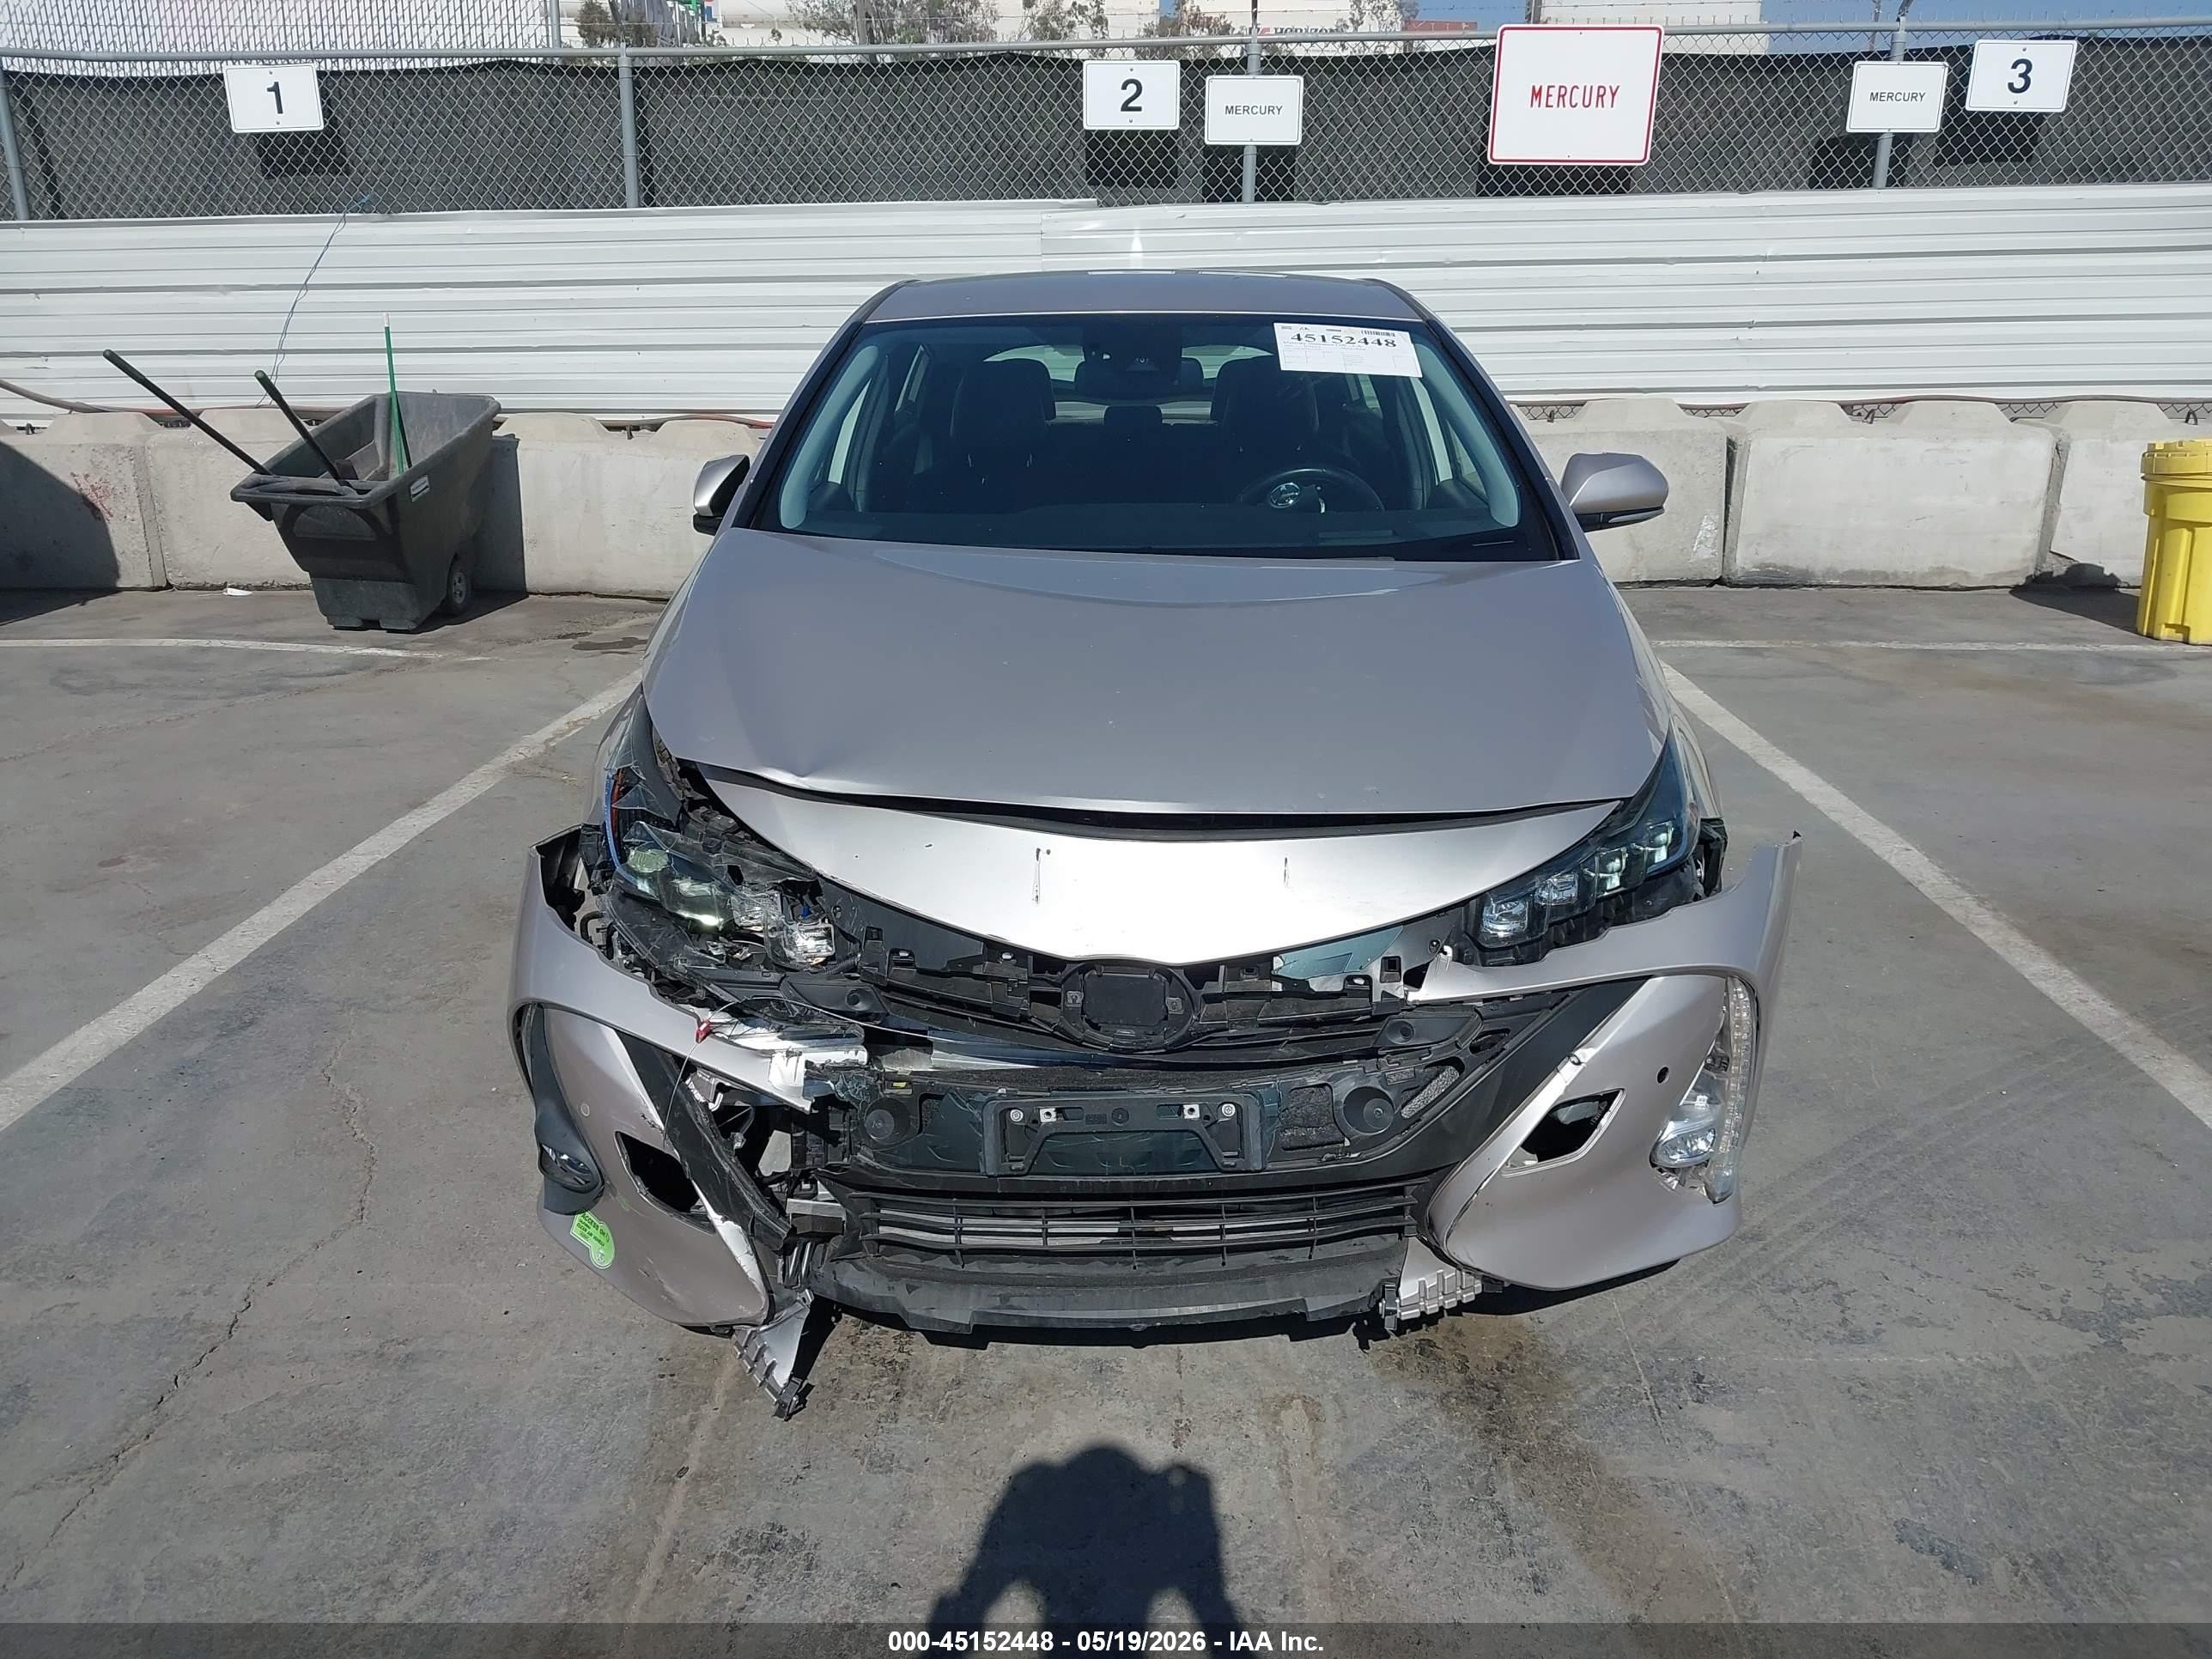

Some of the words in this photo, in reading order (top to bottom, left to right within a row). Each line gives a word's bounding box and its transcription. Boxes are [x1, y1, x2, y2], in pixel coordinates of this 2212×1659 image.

[2007, 58, 2033, 94] 3
[266, 81, 283, 114] 1
[1120, 78, 1143, 112] 2
[1530, 85, 1620, 108] MERCURY
[1869, 91, 1926, 103] MERCURY
[1224, 105, 1283, 115] MERCURY
[1291, 332, 1397, 348] 45152448
